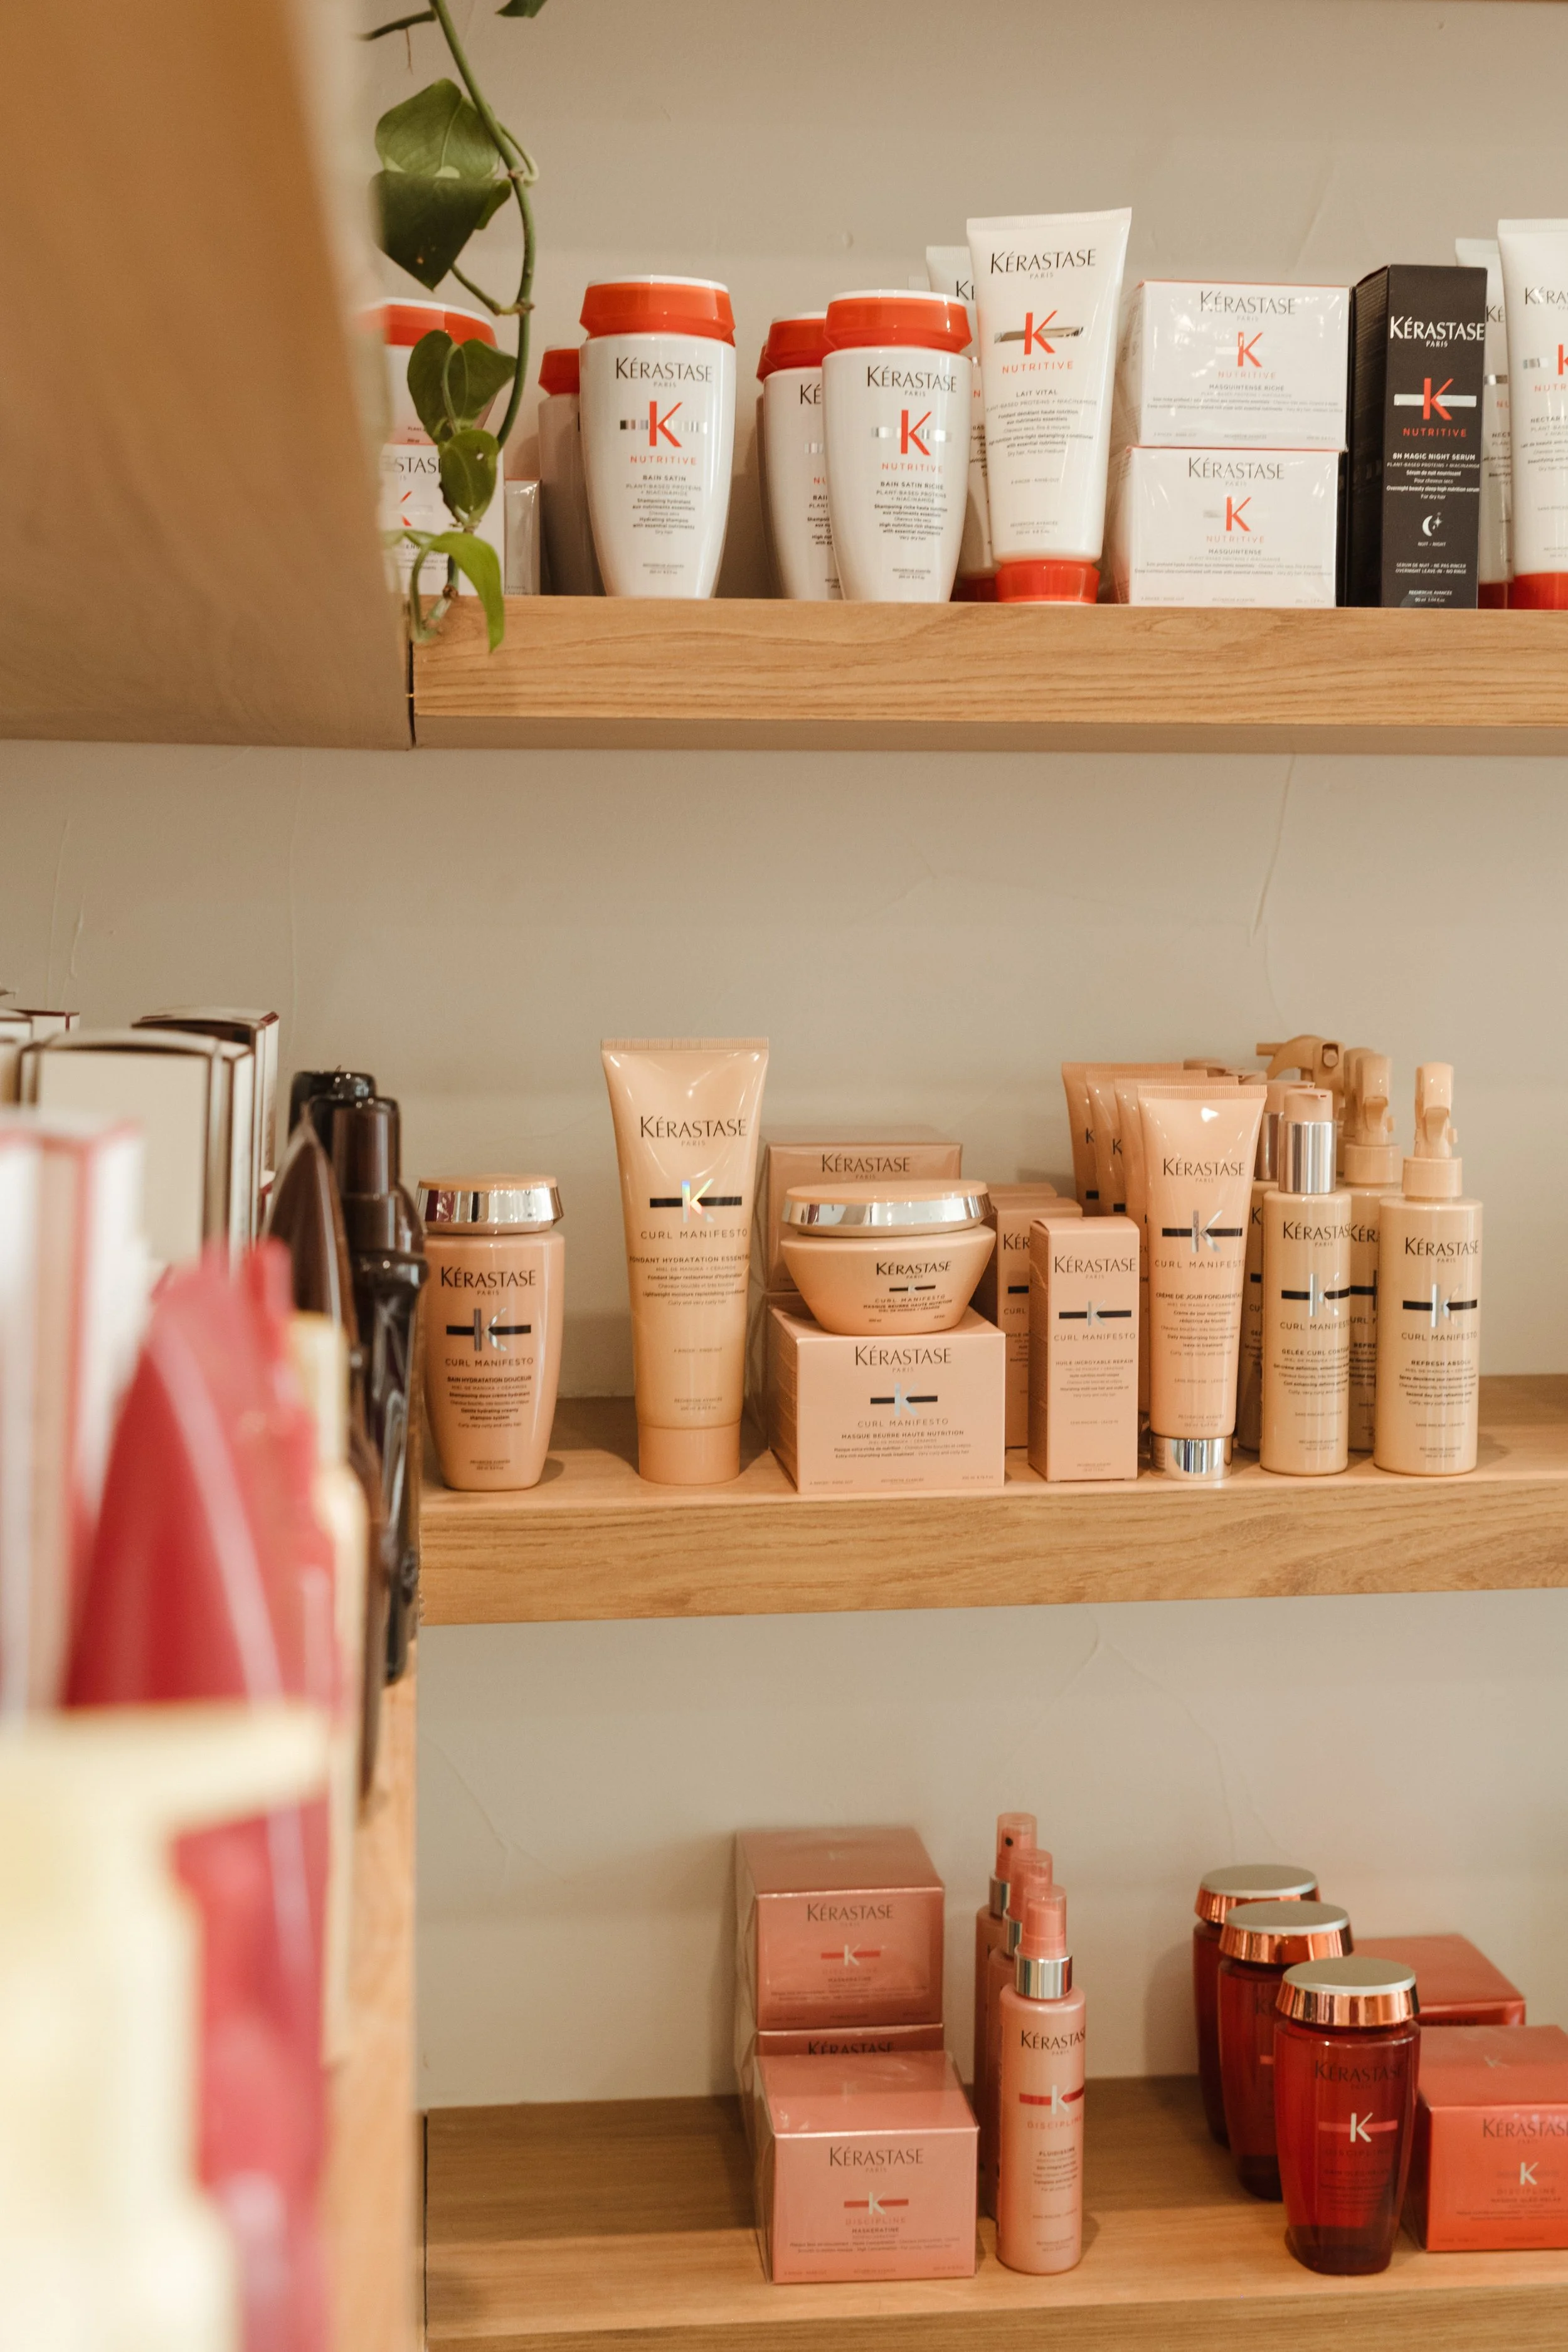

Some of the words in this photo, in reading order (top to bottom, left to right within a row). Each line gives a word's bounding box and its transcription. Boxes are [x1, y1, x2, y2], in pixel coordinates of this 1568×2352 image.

[990, 248, 1096, 274] KÉRASTASE
[1029, 272, 1054, 280] PARIS
[1200, 290, 1296, 315] KÉRASTASE
[1390, 315, 1485, 341] KÉRASTASE
[616, 357, 712, 383] KÉRASTASE
[1002, 361, 1074, 374] NUTRITIVE
[867, 366, 957, 393] KÉRASTASE
[1217, 371, 1277, 379] NUTRITIVE
[1402, 427, 1467, 438] NUTRITIVE
[630, 455, 697, 465] NUTRITIVE
[1404, 452, 1427, 460] MAGIC
[1451, 453, 1476, 461] SERUM
[882, 462, 943, 474] NUTRITIVE
[1188, 456, 1285, 480] KÉRASTASE
[924, 482, 944, 490] RICHE
[1206, 535, 1265, 544] NUTRITIVE
[640, 1115, 747, 1138] KÉRASTASE
[822, 1153, 911, 1173] KÉRASTASE
[1163, 1157, 1246, 1177] KÉRASTASE
[640, 1231, 673, 1240] CURL
[679, 1229, 748, 1239] MANIFESTO
[1405, 1237, 1479, 1256] KÉRASTASE
[662, 1256, 719, 1264] HYDRATATION
[1054, 1255, 1136, 1273] KÉRASTASE
[1155, 1259, 1182, 1268] CURL
[876, 1261, 951, 1276] KÉRASTASE
[441, 1266, 536, 1288] KÉRASTASE
[901, 1294, 946, 1302] MANIFESTO
[1004, 1307, 1026, 1315] CURL
[1279, 1322, 1305, 1330] CURL
[1082, 1332, 1136, 1340] MANIFESTO
[1401, 1332, 1427, 1342] CURL
[1431, 1330, 1478, 1341] MANIFESTO
[855, 1345, 952, 1366] KÉRASTASE
[445, 1357, 470, 1367] CURL
[474, 1357, 534, 1367] MANIFESTO
[504, 1375, 532, 1383] DOUCEUR
[857, 1420, 884, 1428] CURL
[889, 1417, 949, 1427] MANIFESTO
[807, 1903, 893, 1922] KÉRASTASE
[829, 2146, 924, 2167] KÉRASTASE
